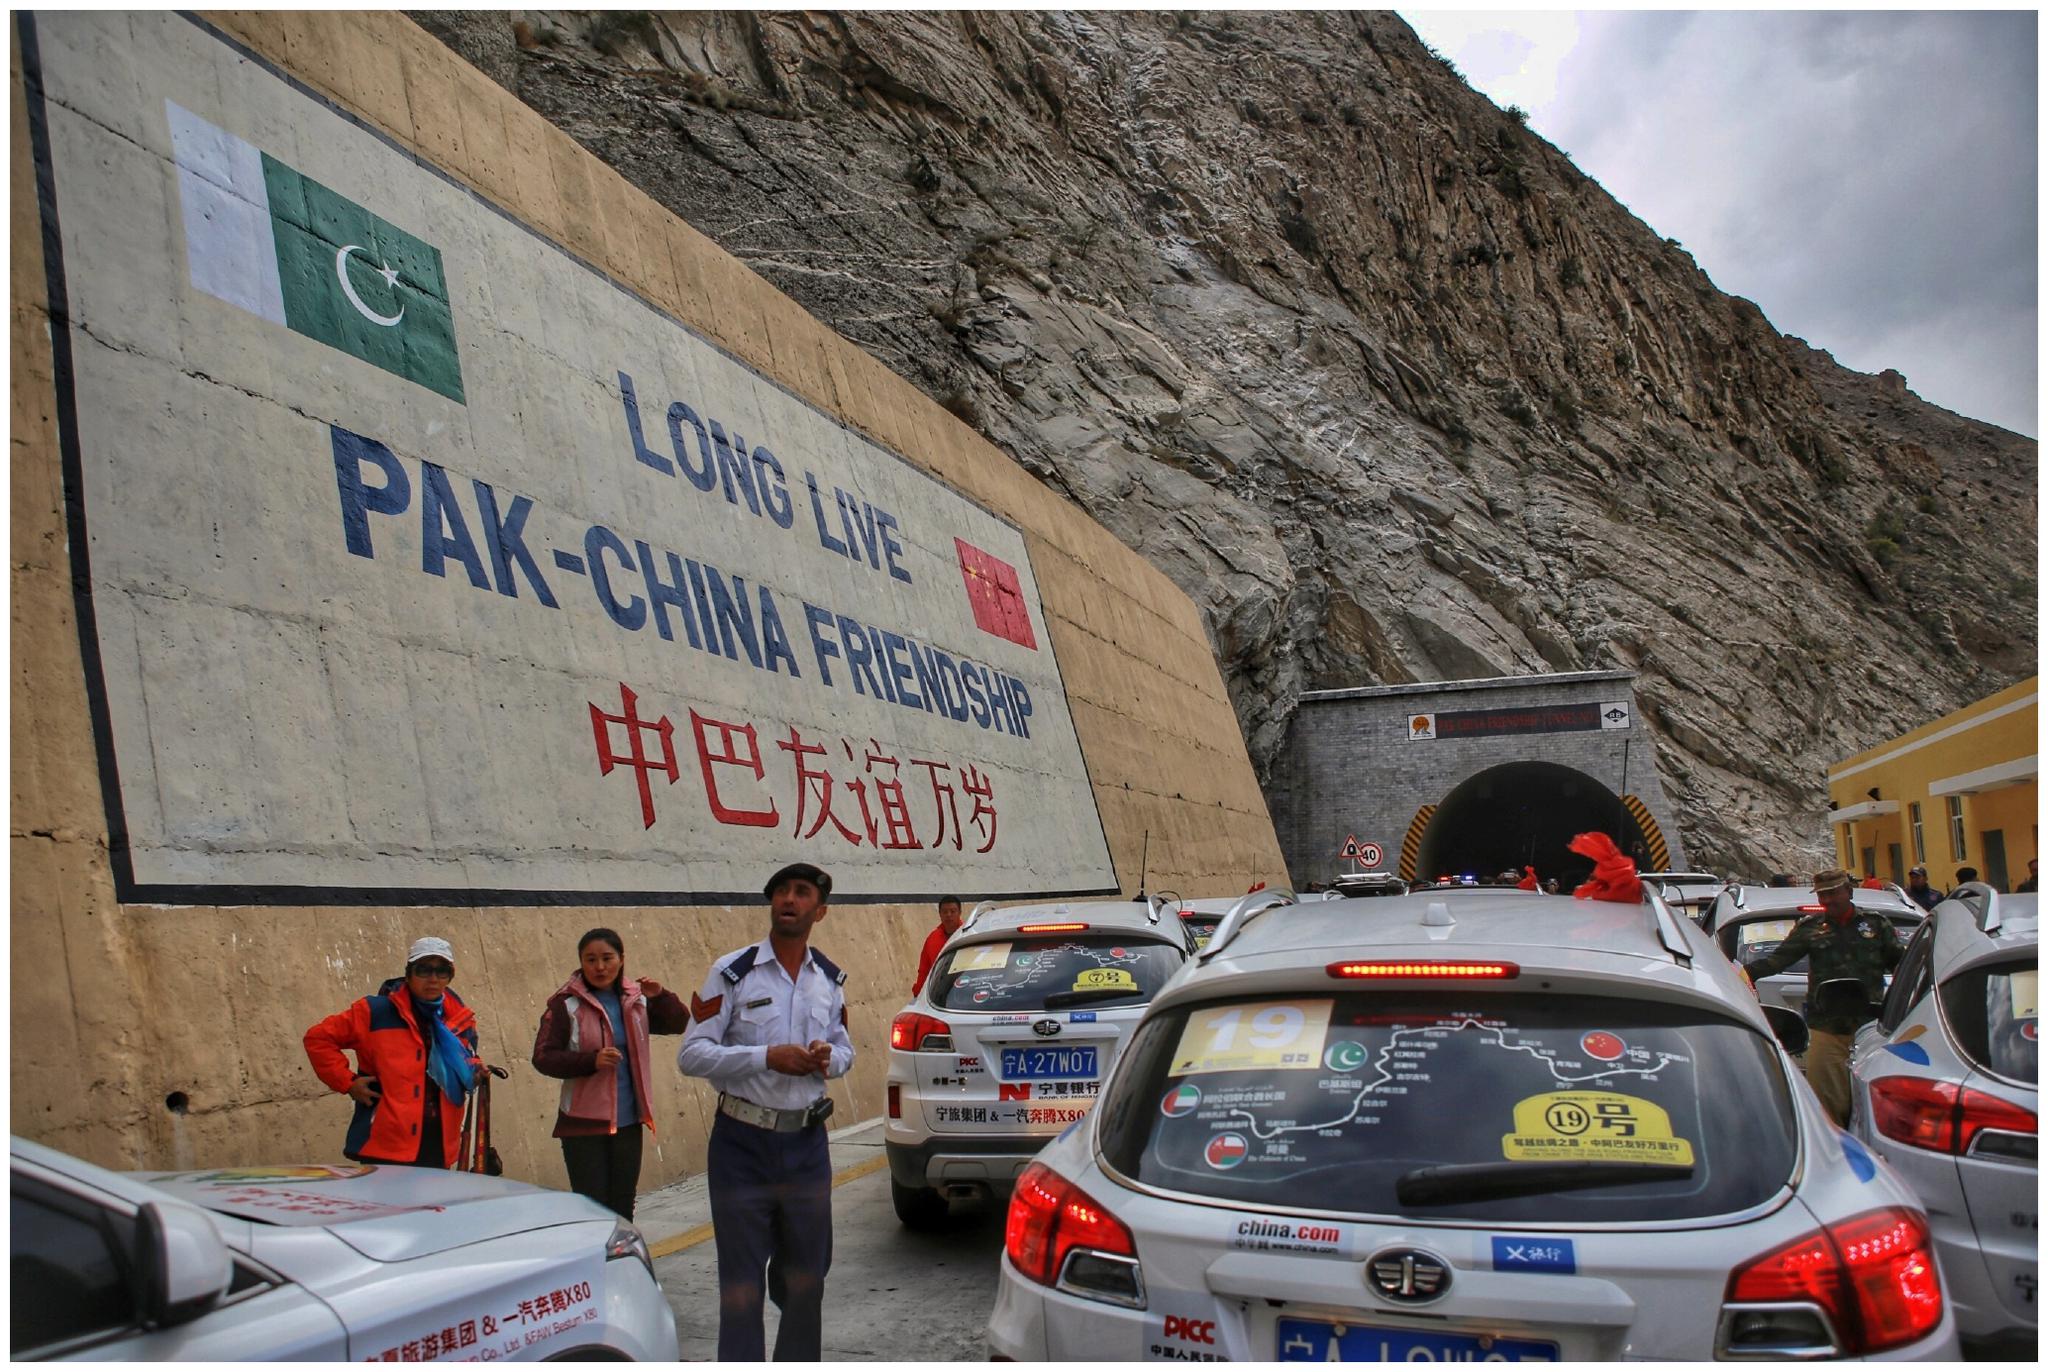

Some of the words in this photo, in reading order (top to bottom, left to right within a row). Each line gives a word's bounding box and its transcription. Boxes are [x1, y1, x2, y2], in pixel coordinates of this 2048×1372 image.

[617, 370, 794, 530] LONG
[805, 471, 912, 585] LIVE
[330, 424, 800, 678] PAK-CHINA
[801, 602, 1034, 740] FRIENDSHIP
[588, 682, 998, 853] 中巴友谊万岁
[1363, 849, 1376, 861] 40
[1206, 1006, 1305, 1051] 19
[960, 1057, 978, 1066] PICC
[1038, 1081, 1101, 1095] 宁夏银行
[990, 1110, 999, 1122] &
[1003, 1108, 1085, 1124] 一汽奔腾X80
[1237, 1219, 1340, 1242] china.com
[365, 1320, 477, 1362] 夏旅游集团
[482, 1315, 499, 1336] &
[502, 1281, 591, 1325] 一汽奔腾X80
[1164, 1314, 1216, 1345] PICC
